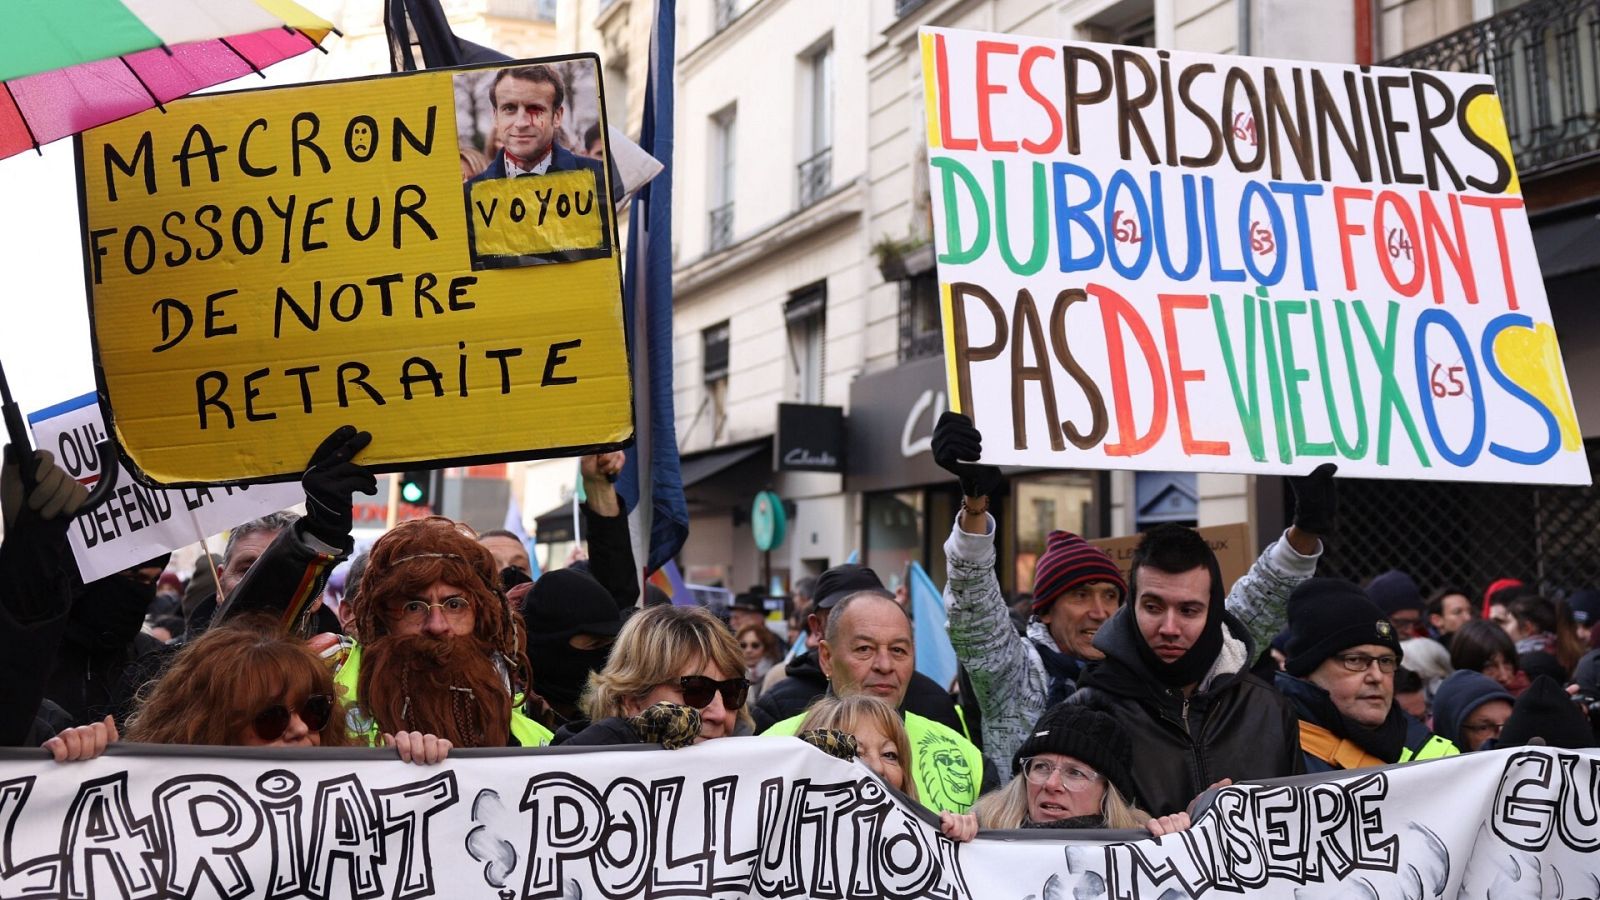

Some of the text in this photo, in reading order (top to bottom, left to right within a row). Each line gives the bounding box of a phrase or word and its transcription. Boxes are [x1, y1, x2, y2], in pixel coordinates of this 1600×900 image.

[935, 33, 1064, 153] LES
[103, 106, 437, 201] MACRON
[90, 184, 438, 285] FOSSOYEUR
[476, 187, 594, 228] VOYOU
[930, 156, 1524, 310] DU BOULOT FONT
[1113, 210, 1144, 244] 62
[1250, 221, 1275, 255] 63
[1388, 228, 1413, 261] 64
[151, 273, 478, 352] DE NOTRE
[950, 282, 1109, 452] PAS
[1086, 283, 1231, 457] DE
[1414, 308, 1562, 467] OS
[1431, 363, 1464, 398] 65
